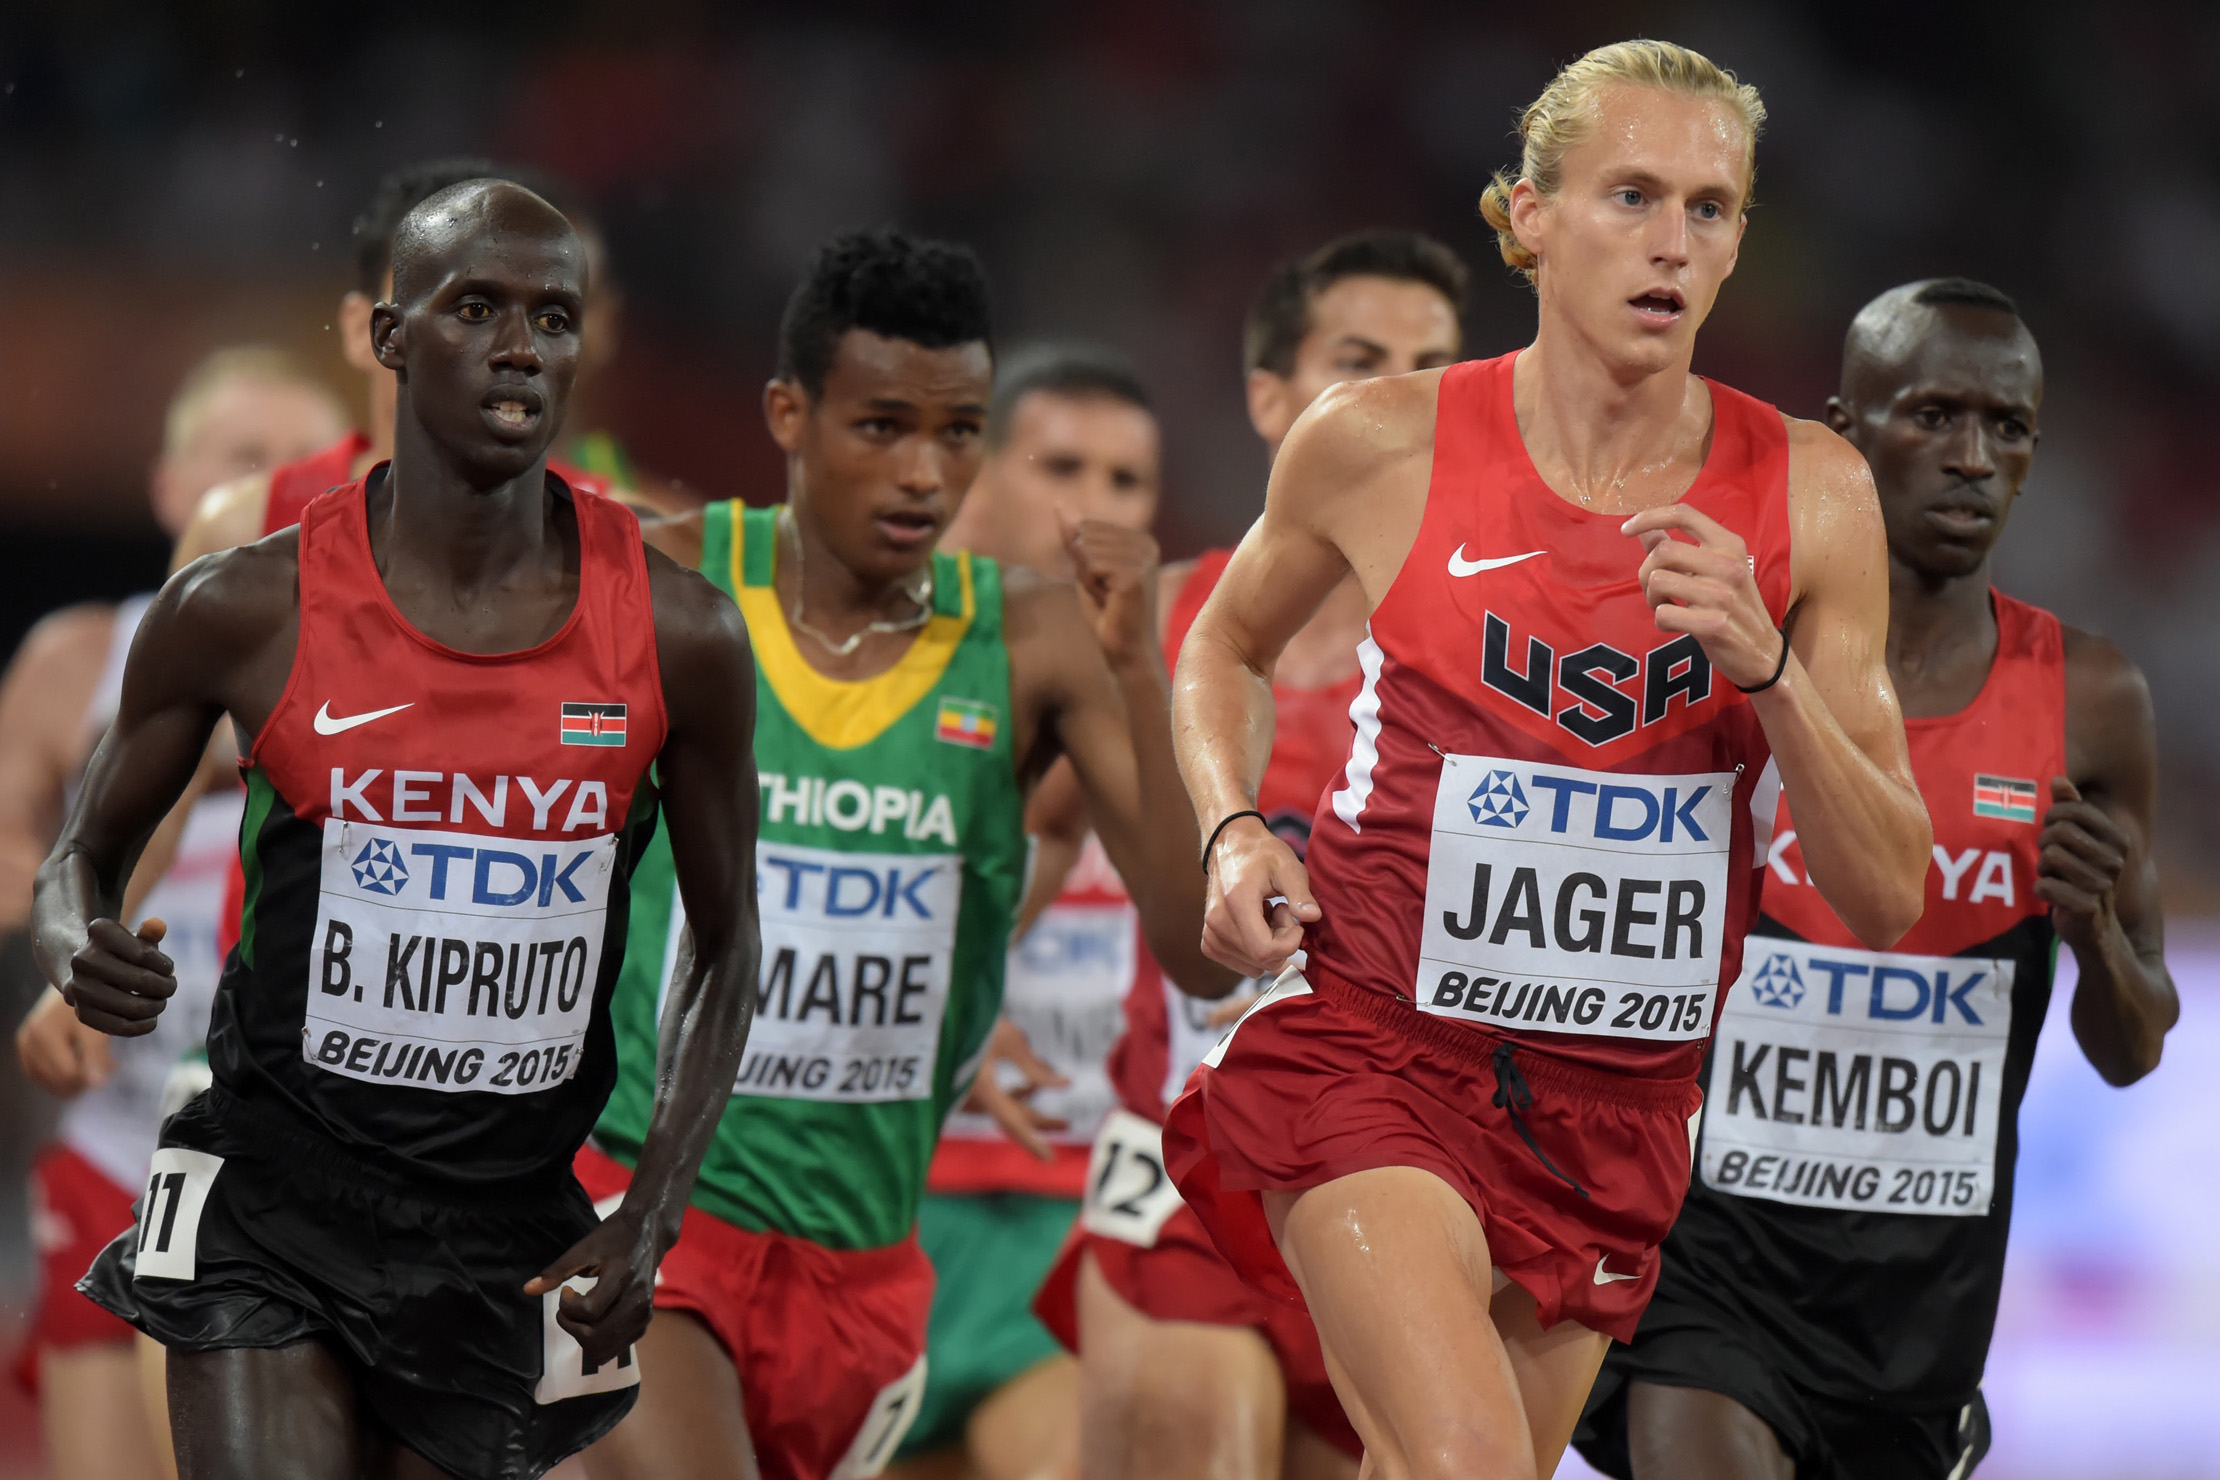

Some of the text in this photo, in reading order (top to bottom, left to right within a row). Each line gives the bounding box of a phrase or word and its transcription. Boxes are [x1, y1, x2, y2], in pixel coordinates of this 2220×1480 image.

[1481, 608, 1713, 748] USA
[330, 767, 607, 832] KENYA
[1532, 774, 1713, 843] TDK
[411, 843, 594, 908] TDK
[766, 856, 937, 920] TDK
[1767, 830, 2015, 907] KYA
[1442, 862, 1707, 961] JAGER
[321, 918, 588, 1020] B. KIPRUTO
[754, 948, 932, 1027] MARE
[1434, 970, 1707, 1033] BEIJING 2015
[1808, 958, 1985, 1026] TDK
[317, 1029, 574, 1087] BEIJING 2015
[736, 1056, 920, 1094] JING 2015
[1726, 1039, 1982, 1138] KEMBOI
[139, 1171, 187, 1253] 11
[1097, 1143, 1163, 1217] 12
[1716, 1150, 1979, 1207] BEIJING 2015
